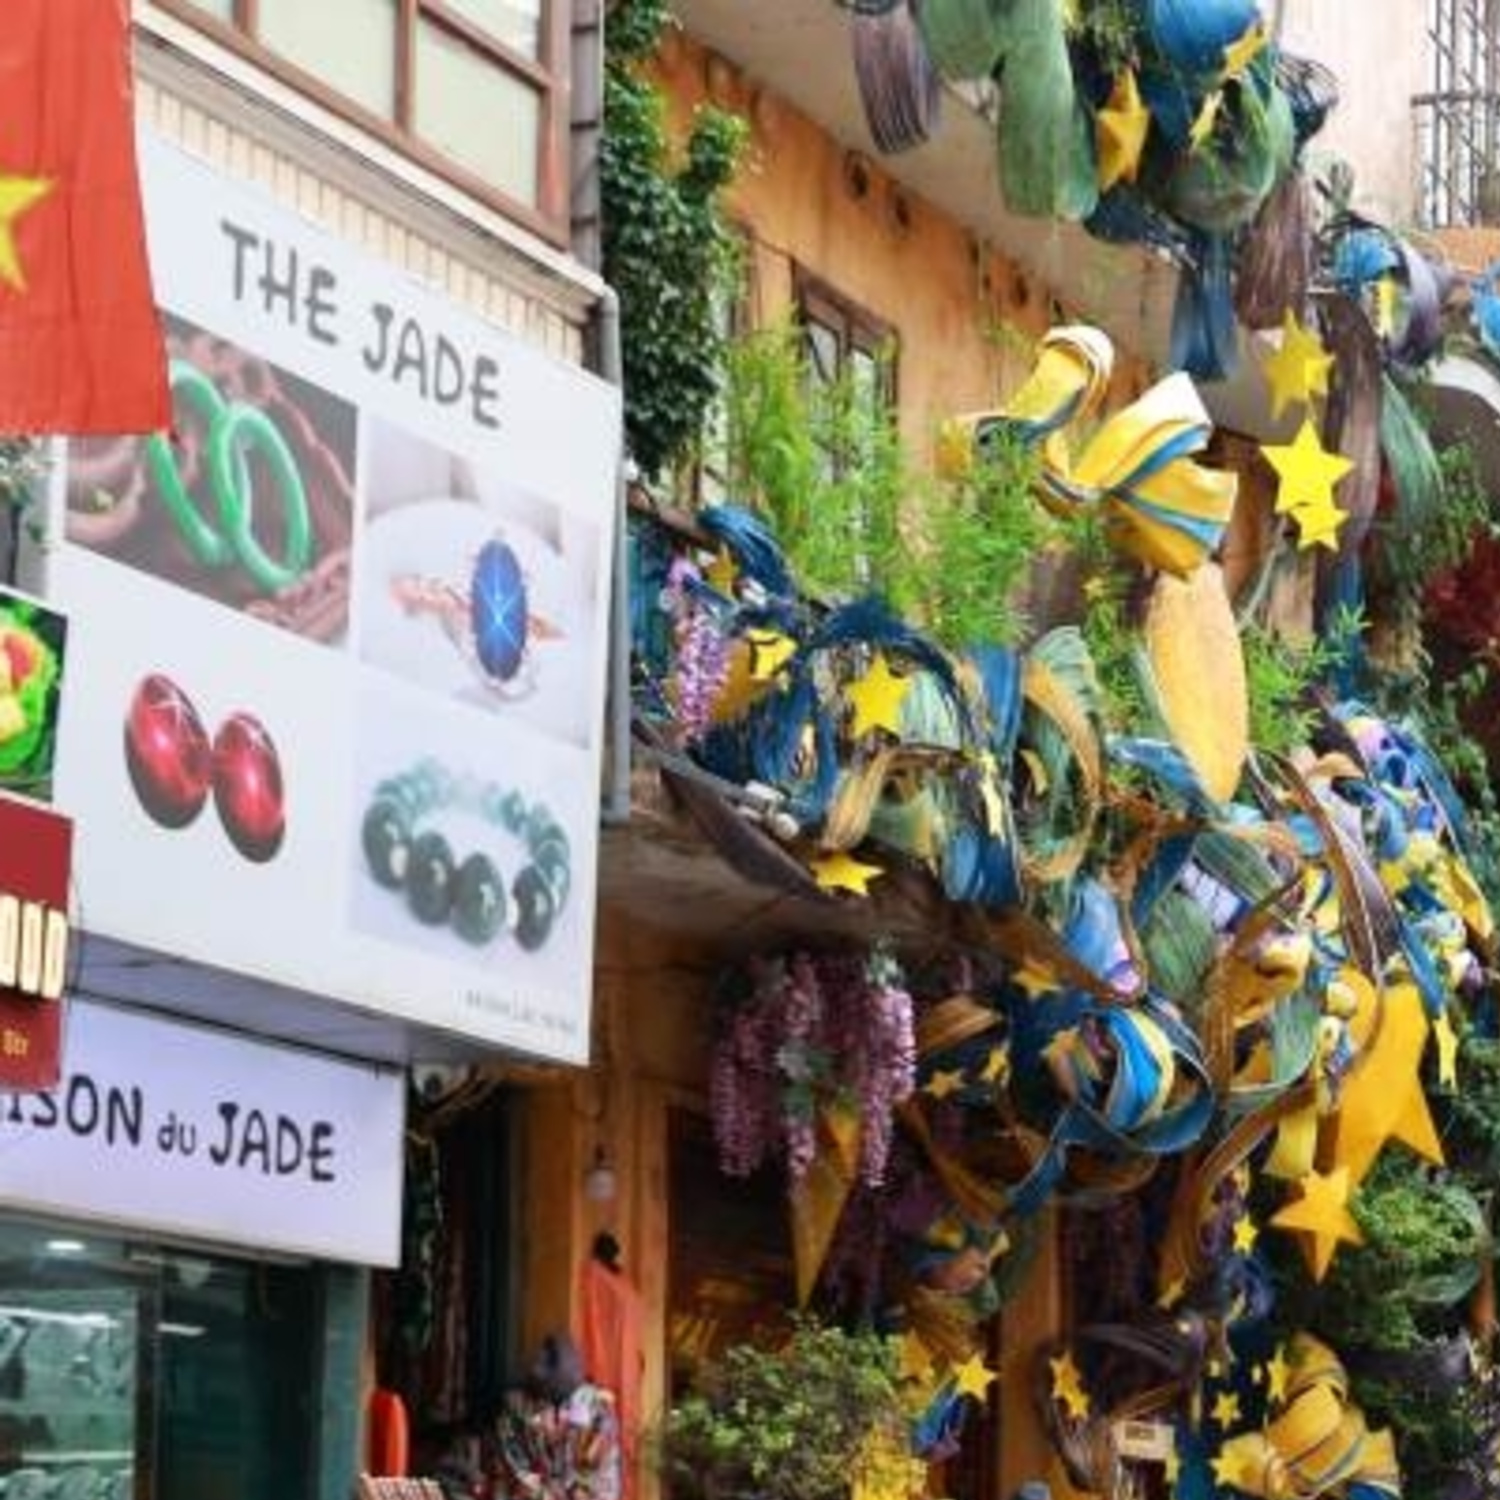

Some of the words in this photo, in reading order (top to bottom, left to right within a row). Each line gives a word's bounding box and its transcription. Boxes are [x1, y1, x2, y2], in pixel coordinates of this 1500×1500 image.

[220, 218, 338, 346] THE
[362, 302, 503, 430] JADE
[157, 1111, 197, 1156] du
[209, 1101, 336, 1182] JADE
